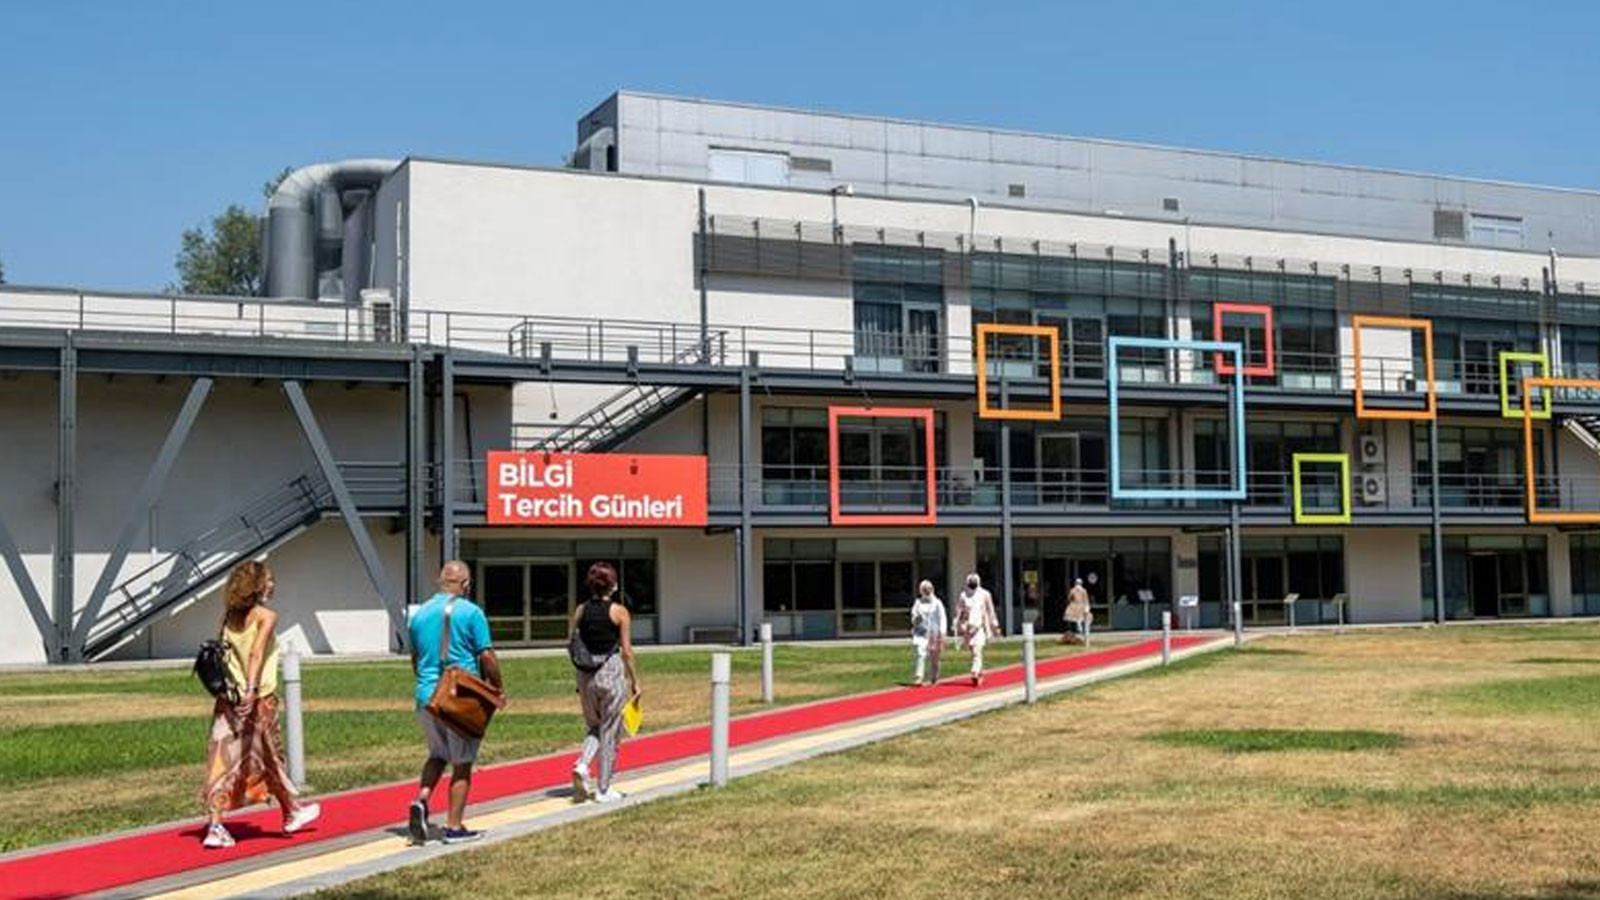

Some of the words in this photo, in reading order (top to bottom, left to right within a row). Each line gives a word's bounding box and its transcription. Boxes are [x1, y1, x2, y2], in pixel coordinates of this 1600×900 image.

[499, 459, 573, 487] BİLGİ
[499, 494, 582, 517] Tercih
[590, 495, 683, 518] Günleri
